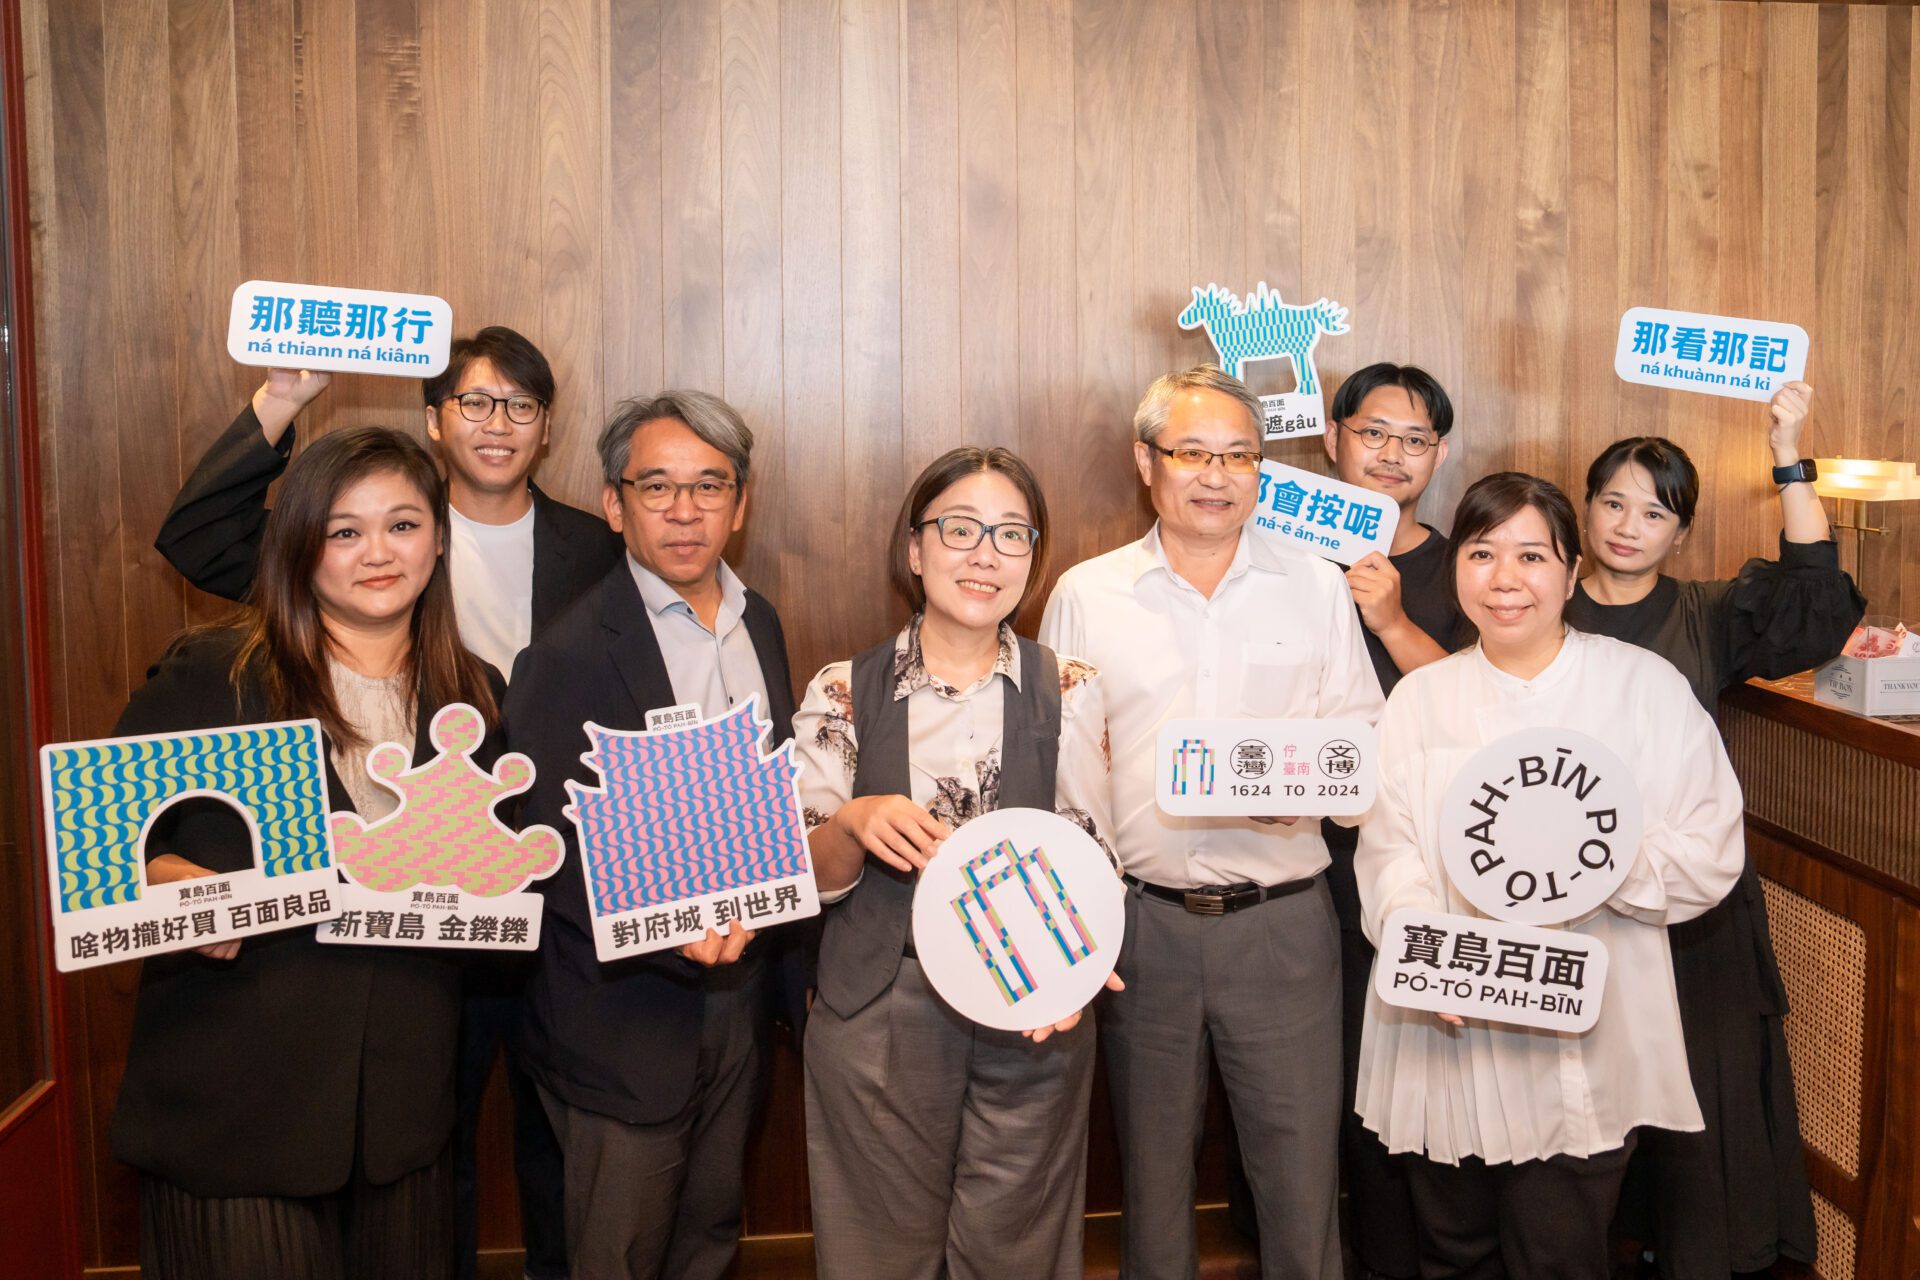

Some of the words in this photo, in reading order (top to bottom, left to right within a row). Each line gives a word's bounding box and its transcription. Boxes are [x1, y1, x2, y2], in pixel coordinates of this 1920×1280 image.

[249, 296, 433, 344] 那聽那行
[247, 338, 272, 353] ná
[278, 341, 342, 359] thiann
[347, 345, 371, 360] ná
[376, 348, 430, 364] kiânn
[1632, 321, 1789, 373] 那看那記
[1640, 362, 1660, 375] ná
[1663, 363, 1726, 384] khuànn
[1730, 373, 1750, 388] ná
[1256, 513, 1292, 535] ná-ē
[1294, 523, 1341, 550] án-ne
[651, 708, 697, 727] 寶島百面
[1230, 784, 1272, 796] 1624
[1283, 784, 1305, 796] TO
[1317, 784, 1360, 796] 2024
[178, 880, 231, 900] 寶島百面
[411, 890, 459, 904] 寶島百面
[71, 908, 217, 960] 啥物攏好買
[228, 889, 331, 930] 百面良品
[330, 910, 425, 940] 新寶島
[612, 905, 703, 949] 對府城
[712, 884, 801, 927] 到世界
[1398, 924, 1589, 991] 寶島百面
[1393, 972, 1472, 998] PÓ-TÓ
[1480, 985, 1583, 1016] PAH-BĪN
